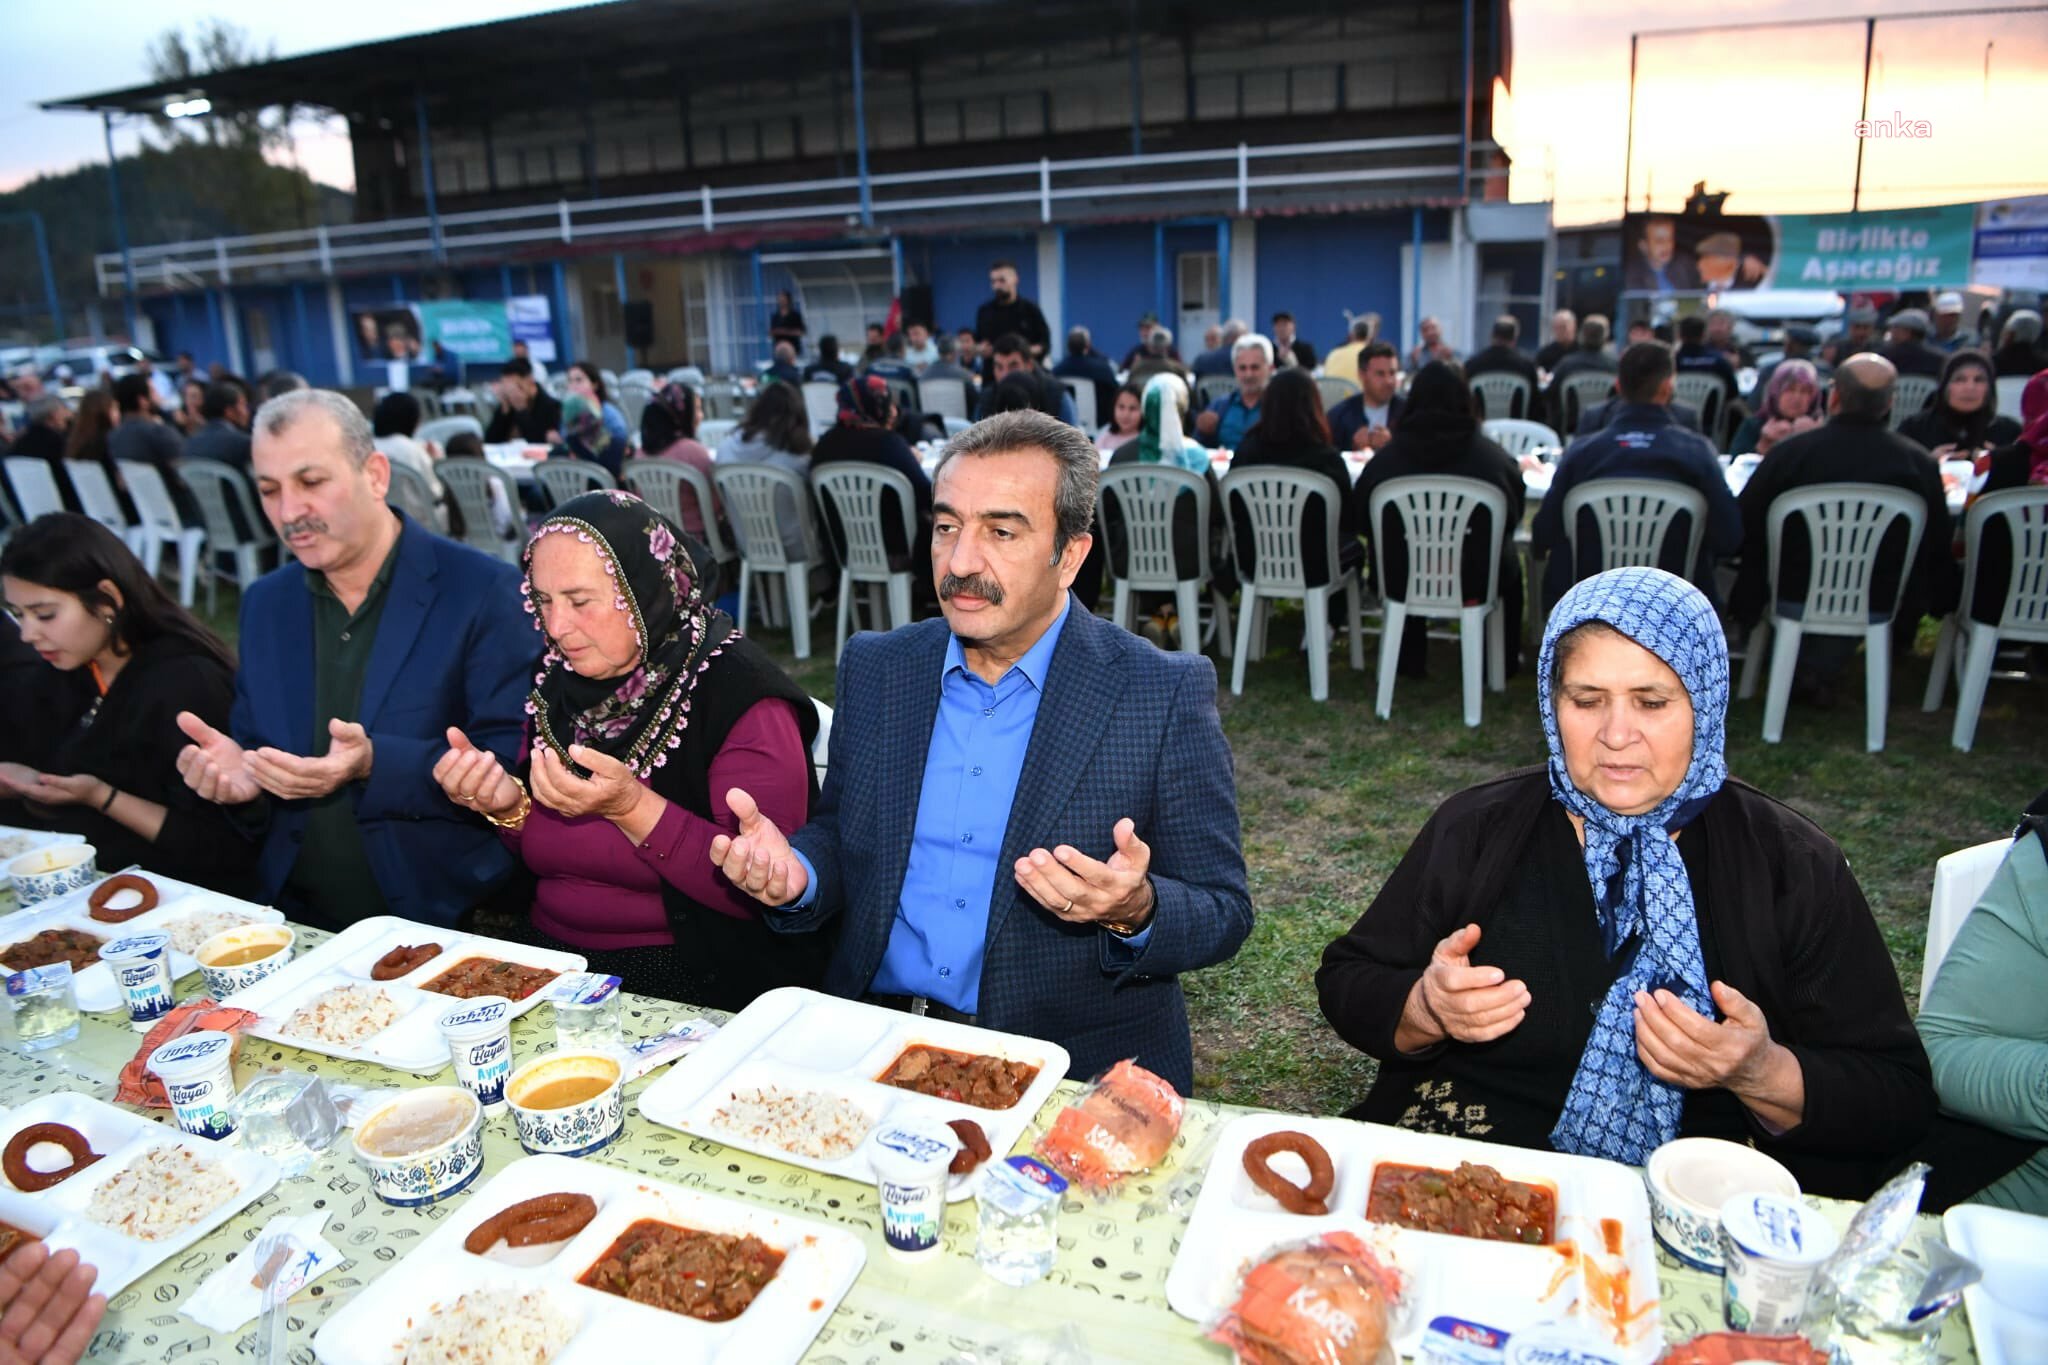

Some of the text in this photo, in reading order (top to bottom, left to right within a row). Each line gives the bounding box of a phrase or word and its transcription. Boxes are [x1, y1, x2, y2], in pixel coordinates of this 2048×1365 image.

[1817, 227, 1929, 252] Birlikte
[1802, 253, 1941, 284] Aşacağız
[129, 984, 162, 1000] Ayran
[474, 1040, 506, 1062] Hayat
[477, 1059, 509, 1081] Ayran
[173, 1083, 208, 1101] Hayat
[178, 1104, 214, 1120] Ayran
[887, 1206, 925, 1224] Ayran
[1287, 1285, 1359, 1348] KARE
